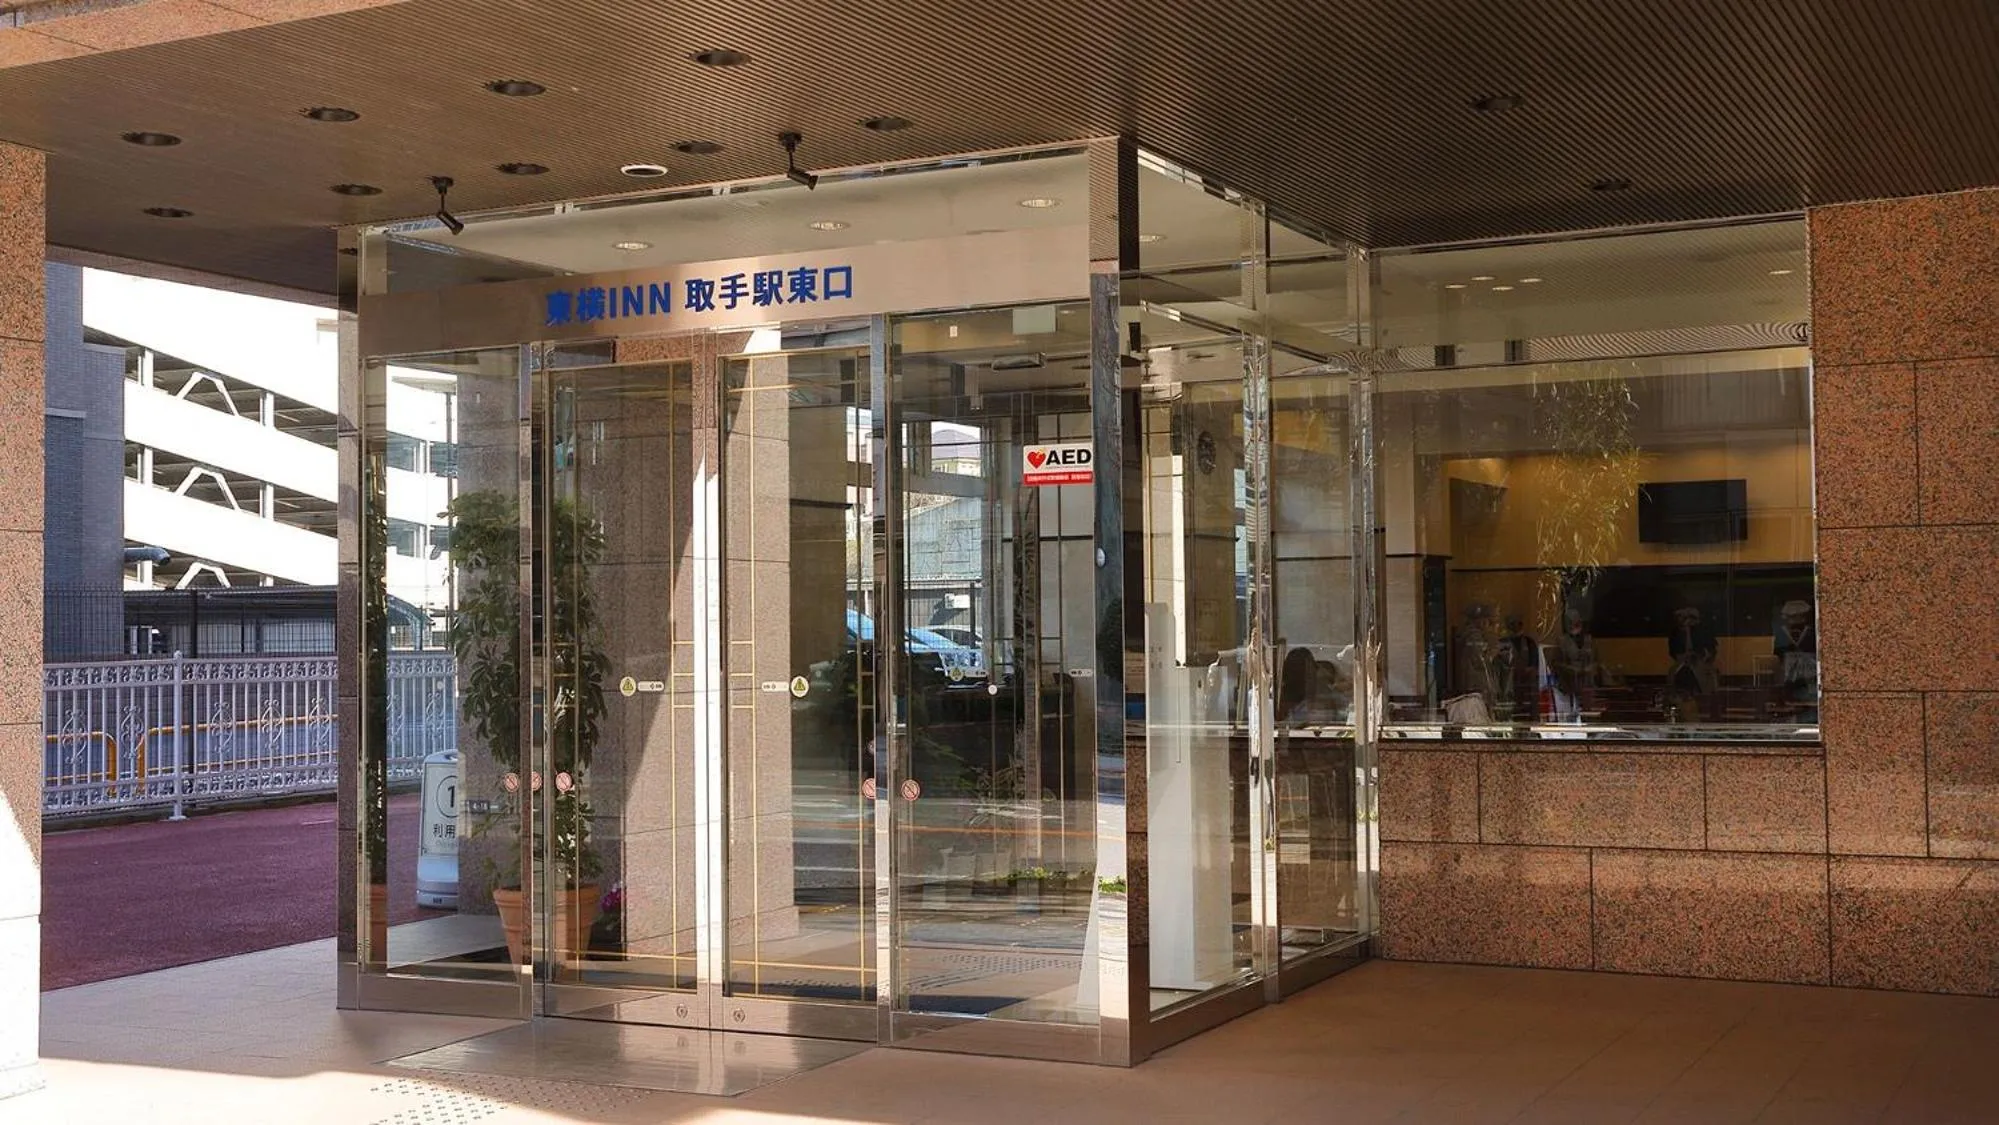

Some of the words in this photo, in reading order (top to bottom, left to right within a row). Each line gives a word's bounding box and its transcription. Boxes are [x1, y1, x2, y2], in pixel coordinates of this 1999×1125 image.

[545, 281, 671, 327] 東横INN
[685, 266, 853, 313] 取手駅東口
[1046, 449, 1092, 465] AED
[432, 823, 456, 839] 利用
